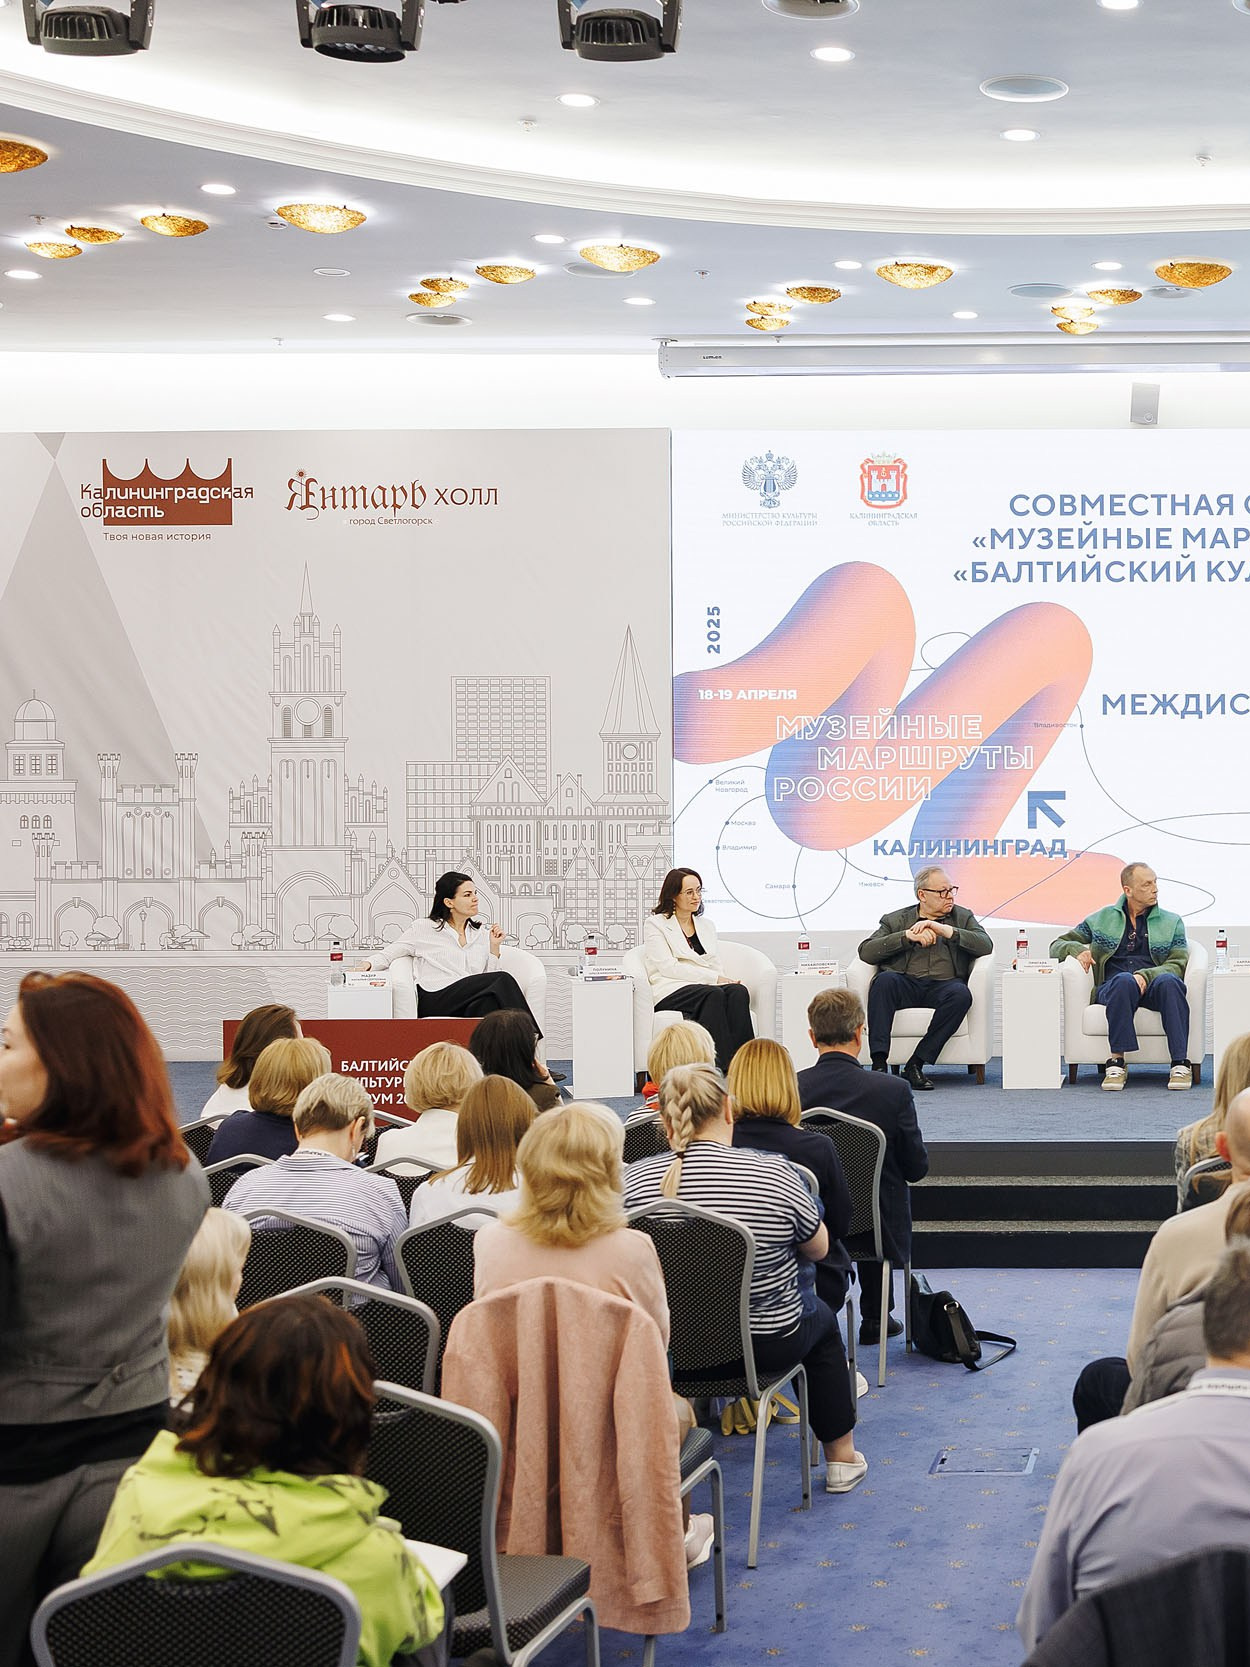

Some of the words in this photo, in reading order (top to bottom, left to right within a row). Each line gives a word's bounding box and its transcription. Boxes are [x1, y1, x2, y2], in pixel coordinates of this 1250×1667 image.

[80, 483, 254, 504] Калининградская
[284, 475, 428, 521] Янтарь
[1009, 493, 1234, 517] СОВМЕСТНАЯ
[80, 502, 165, 518] область
[349, 518, 376, 526] город
[377, 516, 433, 526] Светлогорск
[103, 532, 129, 541] Твоя
[131, 533, 163, 541] новая
[166, 532, 212, 543] история
[972, 521, 1173, 550] «МУЗЕЙНЫЕ
[953, 554, 1196, 584] «БАЛТИЙСКИЙ
[707, 606, 720, 654] 2025
[698, 689, 733, 700] 18-19
[736, 689, 797, 700] АПРЕЛЯ
[776, 708, 983, 740] МУЗЕЙНЫЕ
[817, 745, 1034, 770] МАРШРУТЫ
[774, 776, 932, 801] РОССИИ
[873, 839, 1069, 860] КАЛИНИНГРАД
[341, 1058, 412, 1072] БАЛТИЙС
